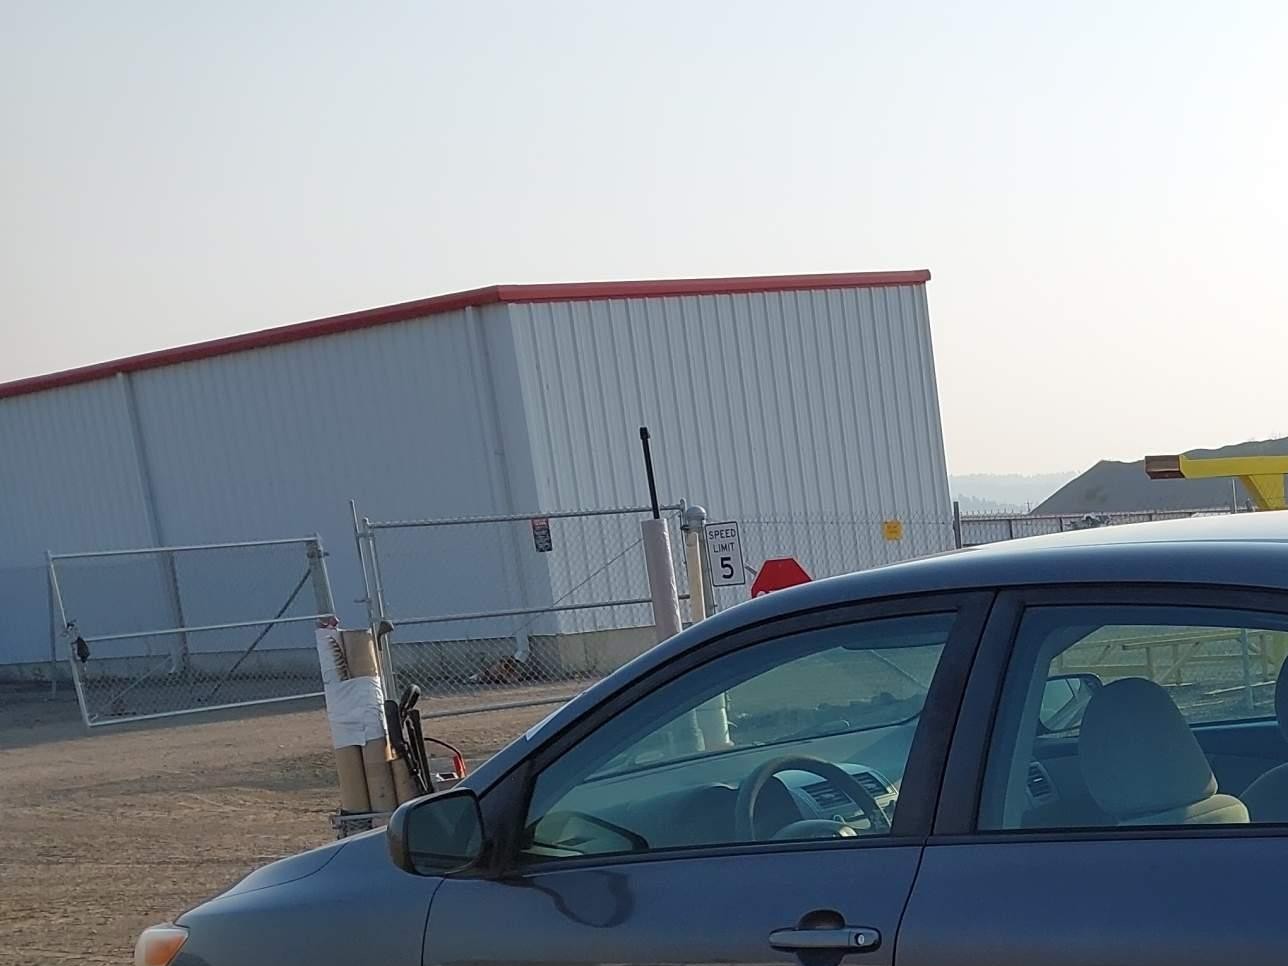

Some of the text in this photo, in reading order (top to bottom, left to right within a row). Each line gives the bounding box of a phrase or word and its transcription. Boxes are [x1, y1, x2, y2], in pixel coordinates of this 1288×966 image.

[708, 528, 737, 540] SPEED
[713, 542, 735, 553] LIMIT
[720, 556, 734, 579] 5
